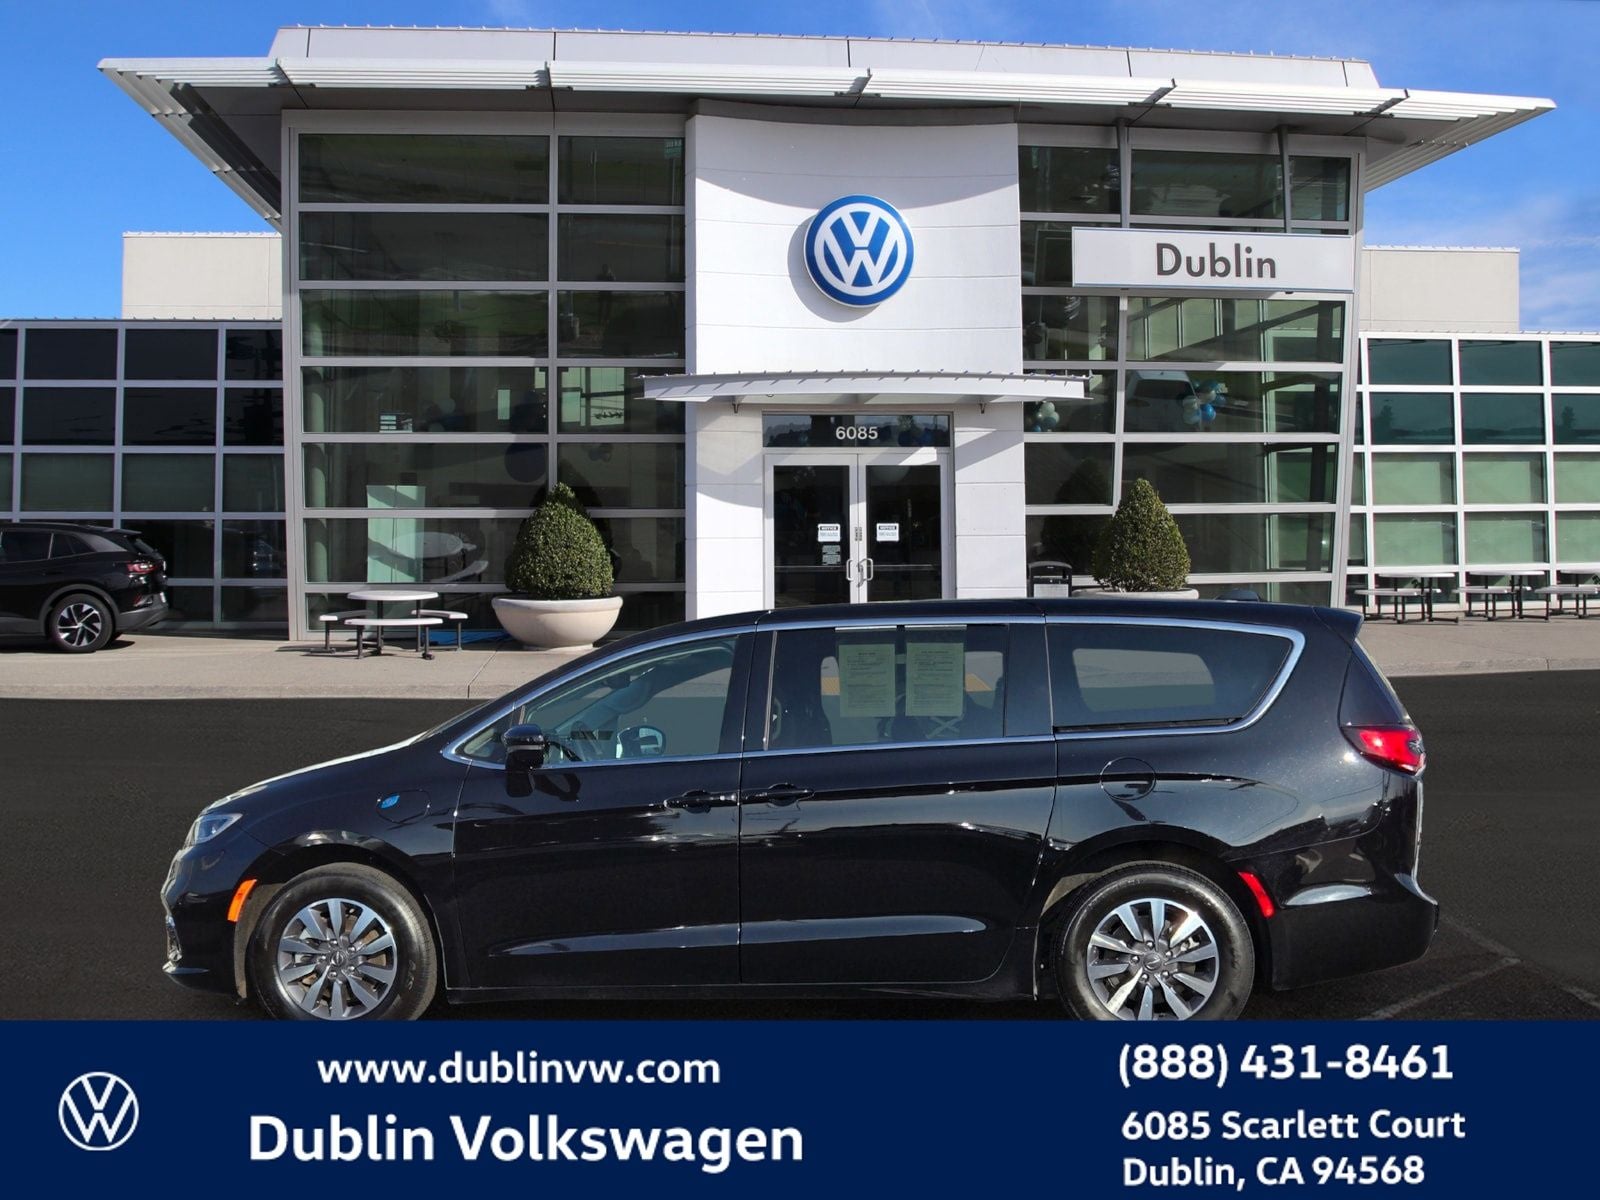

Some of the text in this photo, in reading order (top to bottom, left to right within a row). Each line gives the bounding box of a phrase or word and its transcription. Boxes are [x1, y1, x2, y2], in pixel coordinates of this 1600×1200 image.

[814, 203, 907, 296] VW
[1156, 242, 1277, 279] Dublin
[835, 426, 878, 440] 6085
